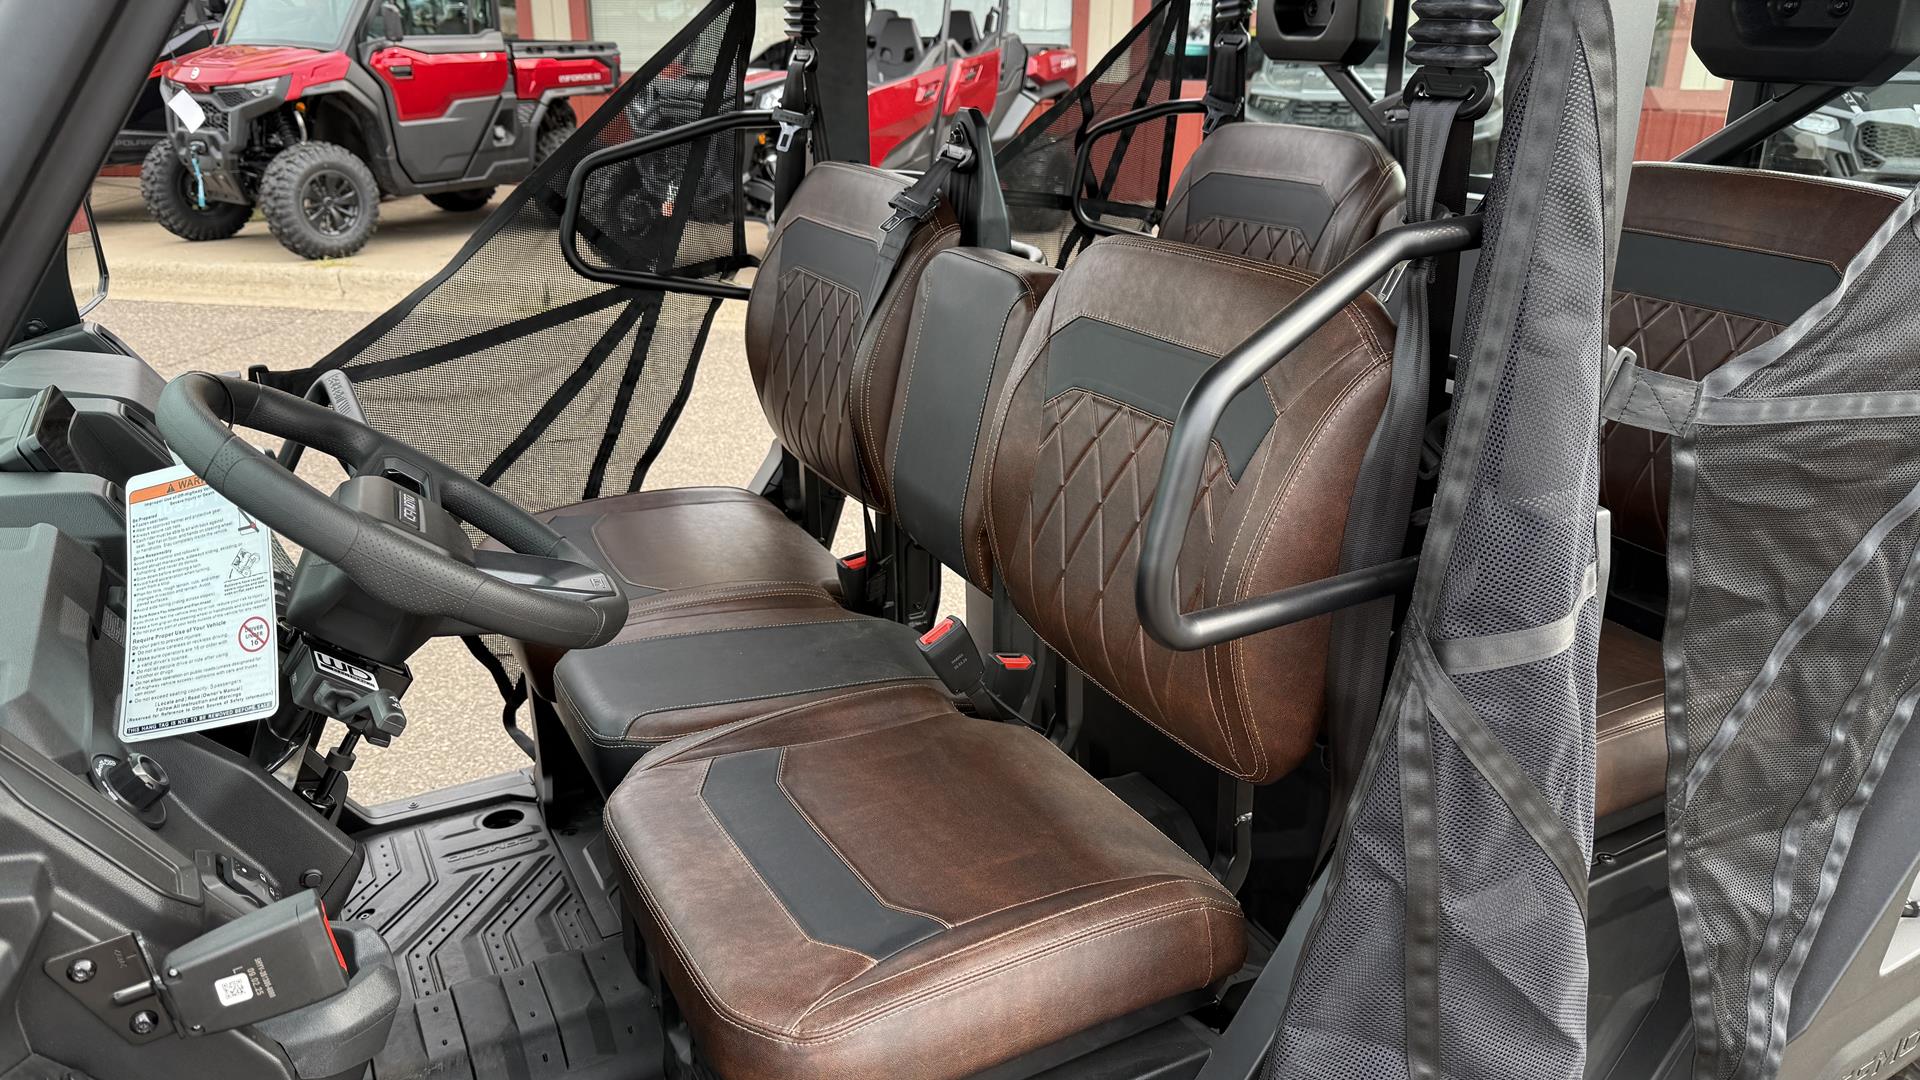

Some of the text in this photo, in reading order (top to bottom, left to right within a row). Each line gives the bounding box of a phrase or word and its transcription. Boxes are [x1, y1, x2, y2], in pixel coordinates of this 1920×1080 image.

[138, 513, 157, 522] Prepared
[145, 549, 172, 558] Responsibly
[132, 636, 154, 644] Require
[206, 620, 226, 629] Vehicle
[250, 638, 259, 646] 16
[141, 723, 156, 731] HANG
[158, 720, 169, 728] TAG
[207, 708, 233, 718] REMOVED
